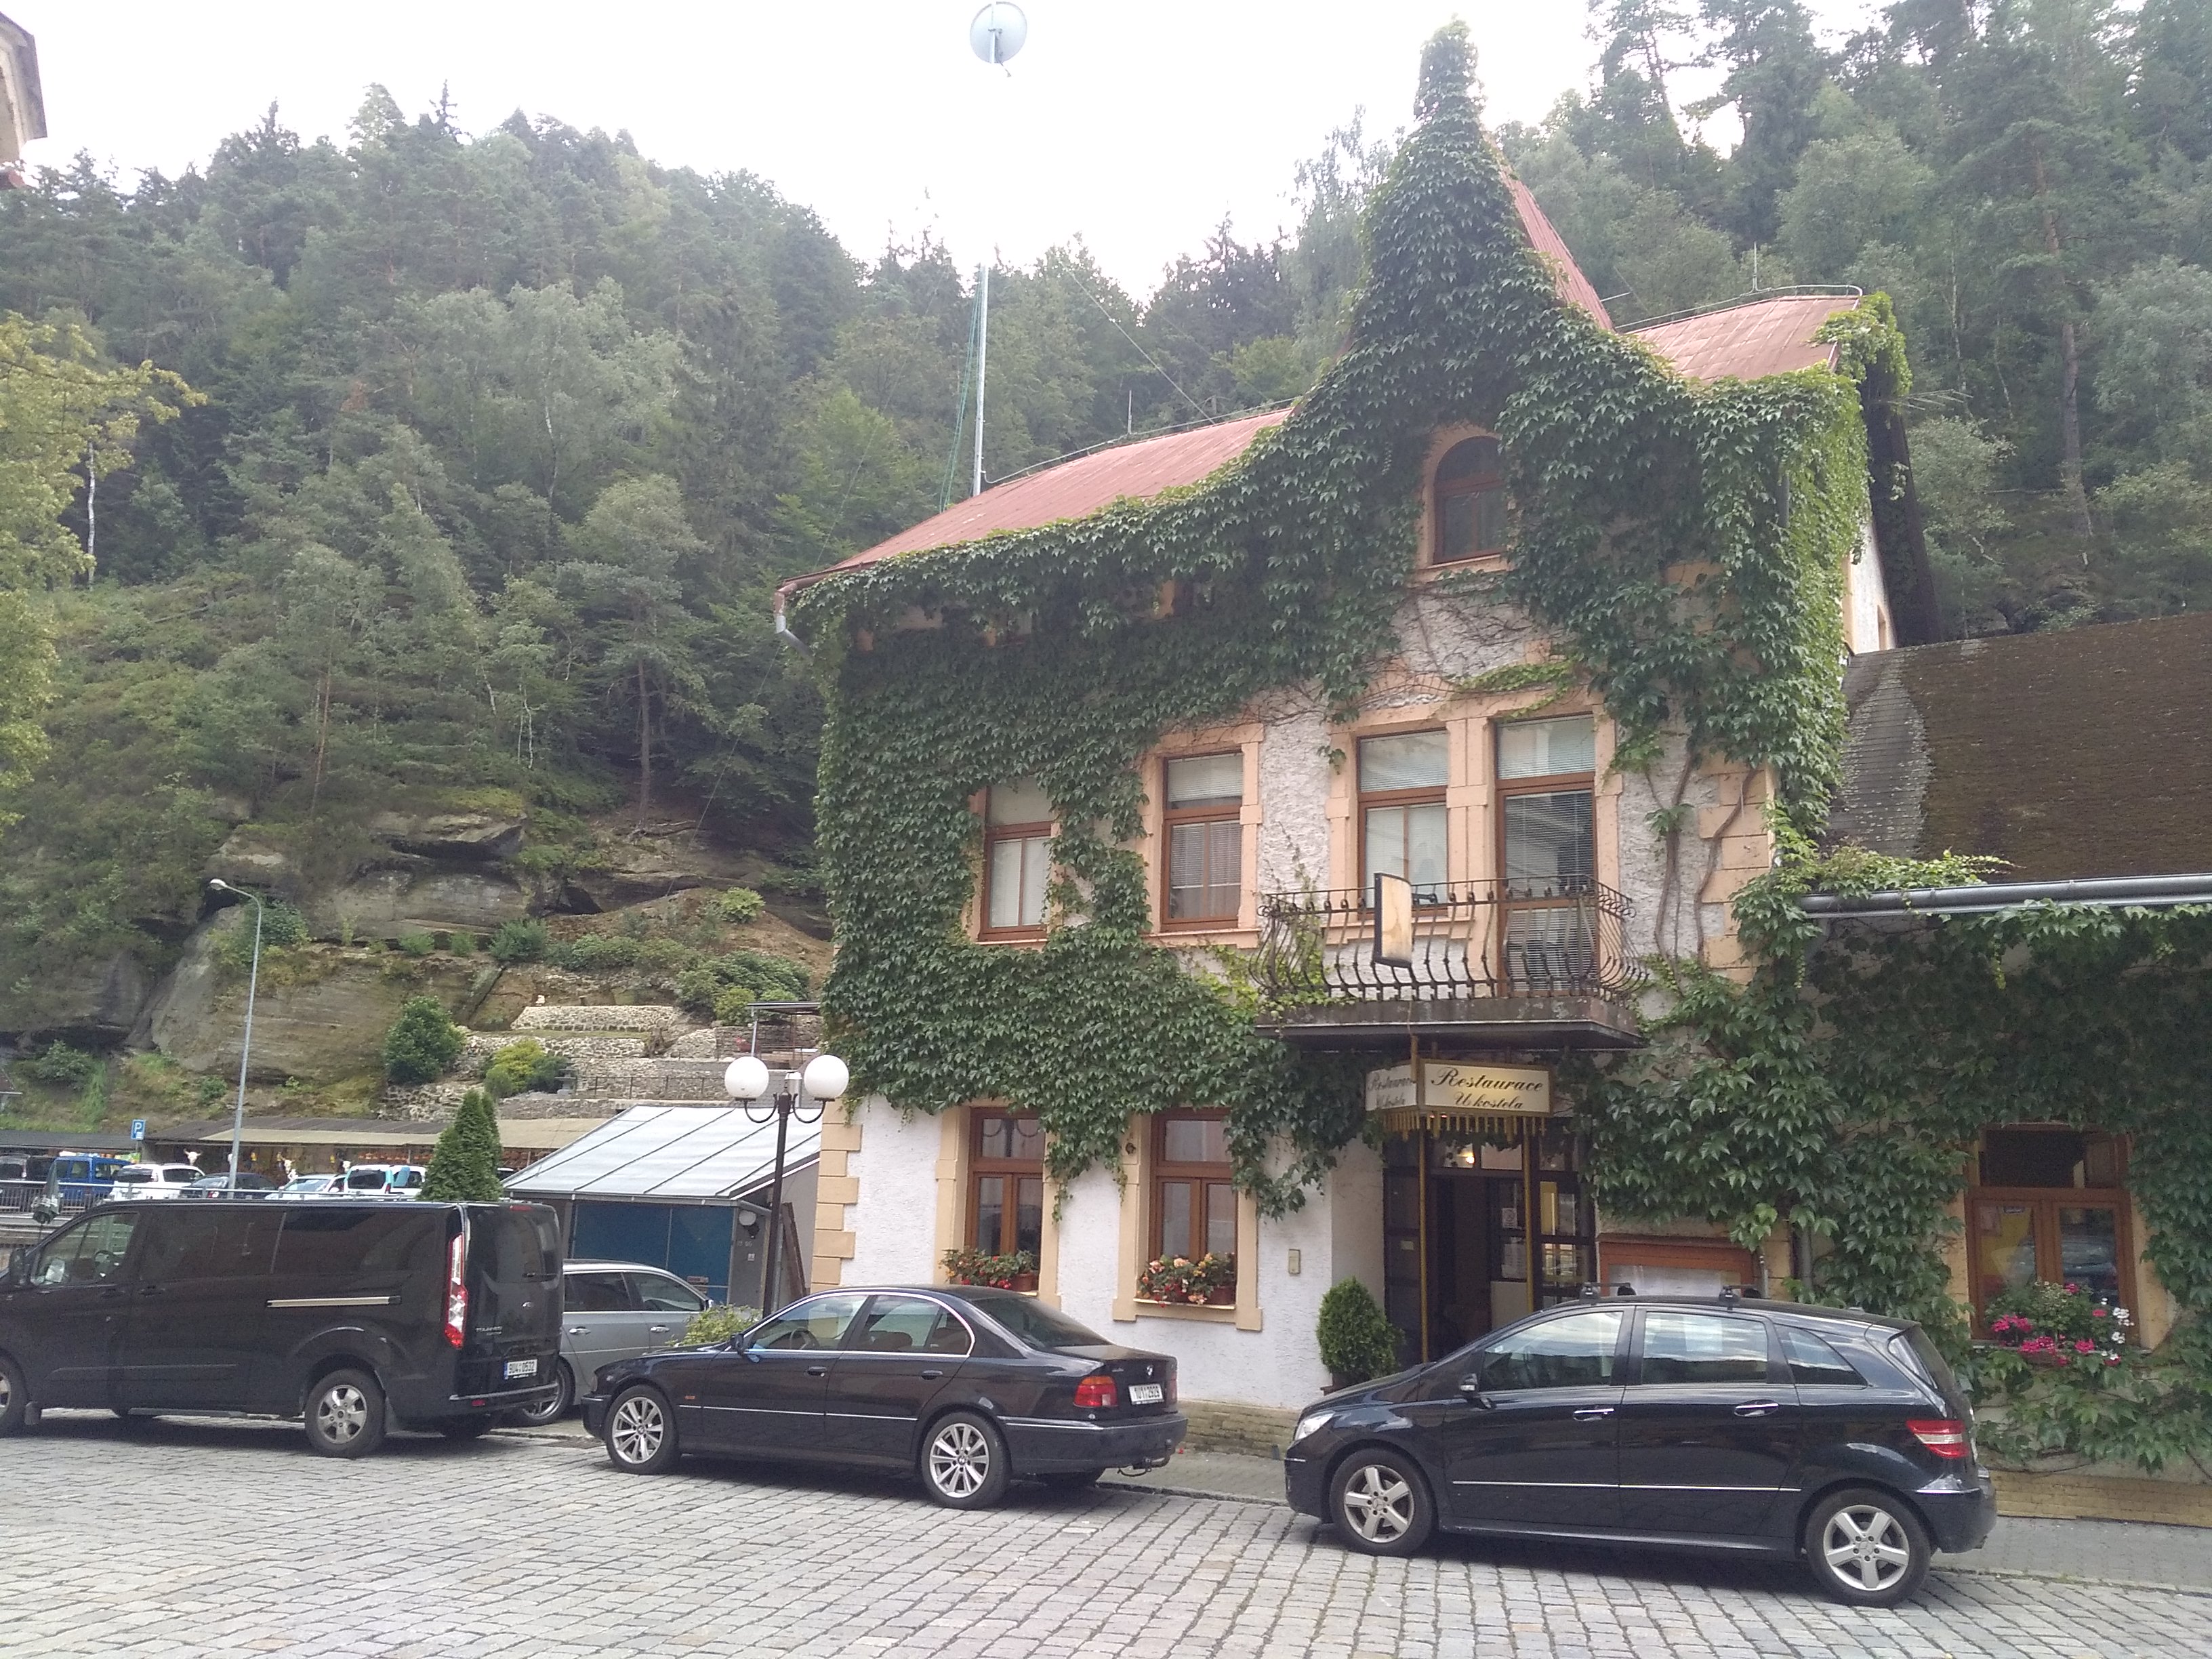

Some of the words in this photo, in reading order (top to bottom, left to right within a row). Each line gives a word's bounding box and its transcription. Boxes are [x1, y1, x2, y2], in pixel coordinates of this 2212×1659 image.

[1431, 1067, 1544, 1092] Restaurace
[1455, 1091, 1470, 1106] U
[1472, 1093, 1524, 1109] kostela
[134, 1122, 142, 1134] P
